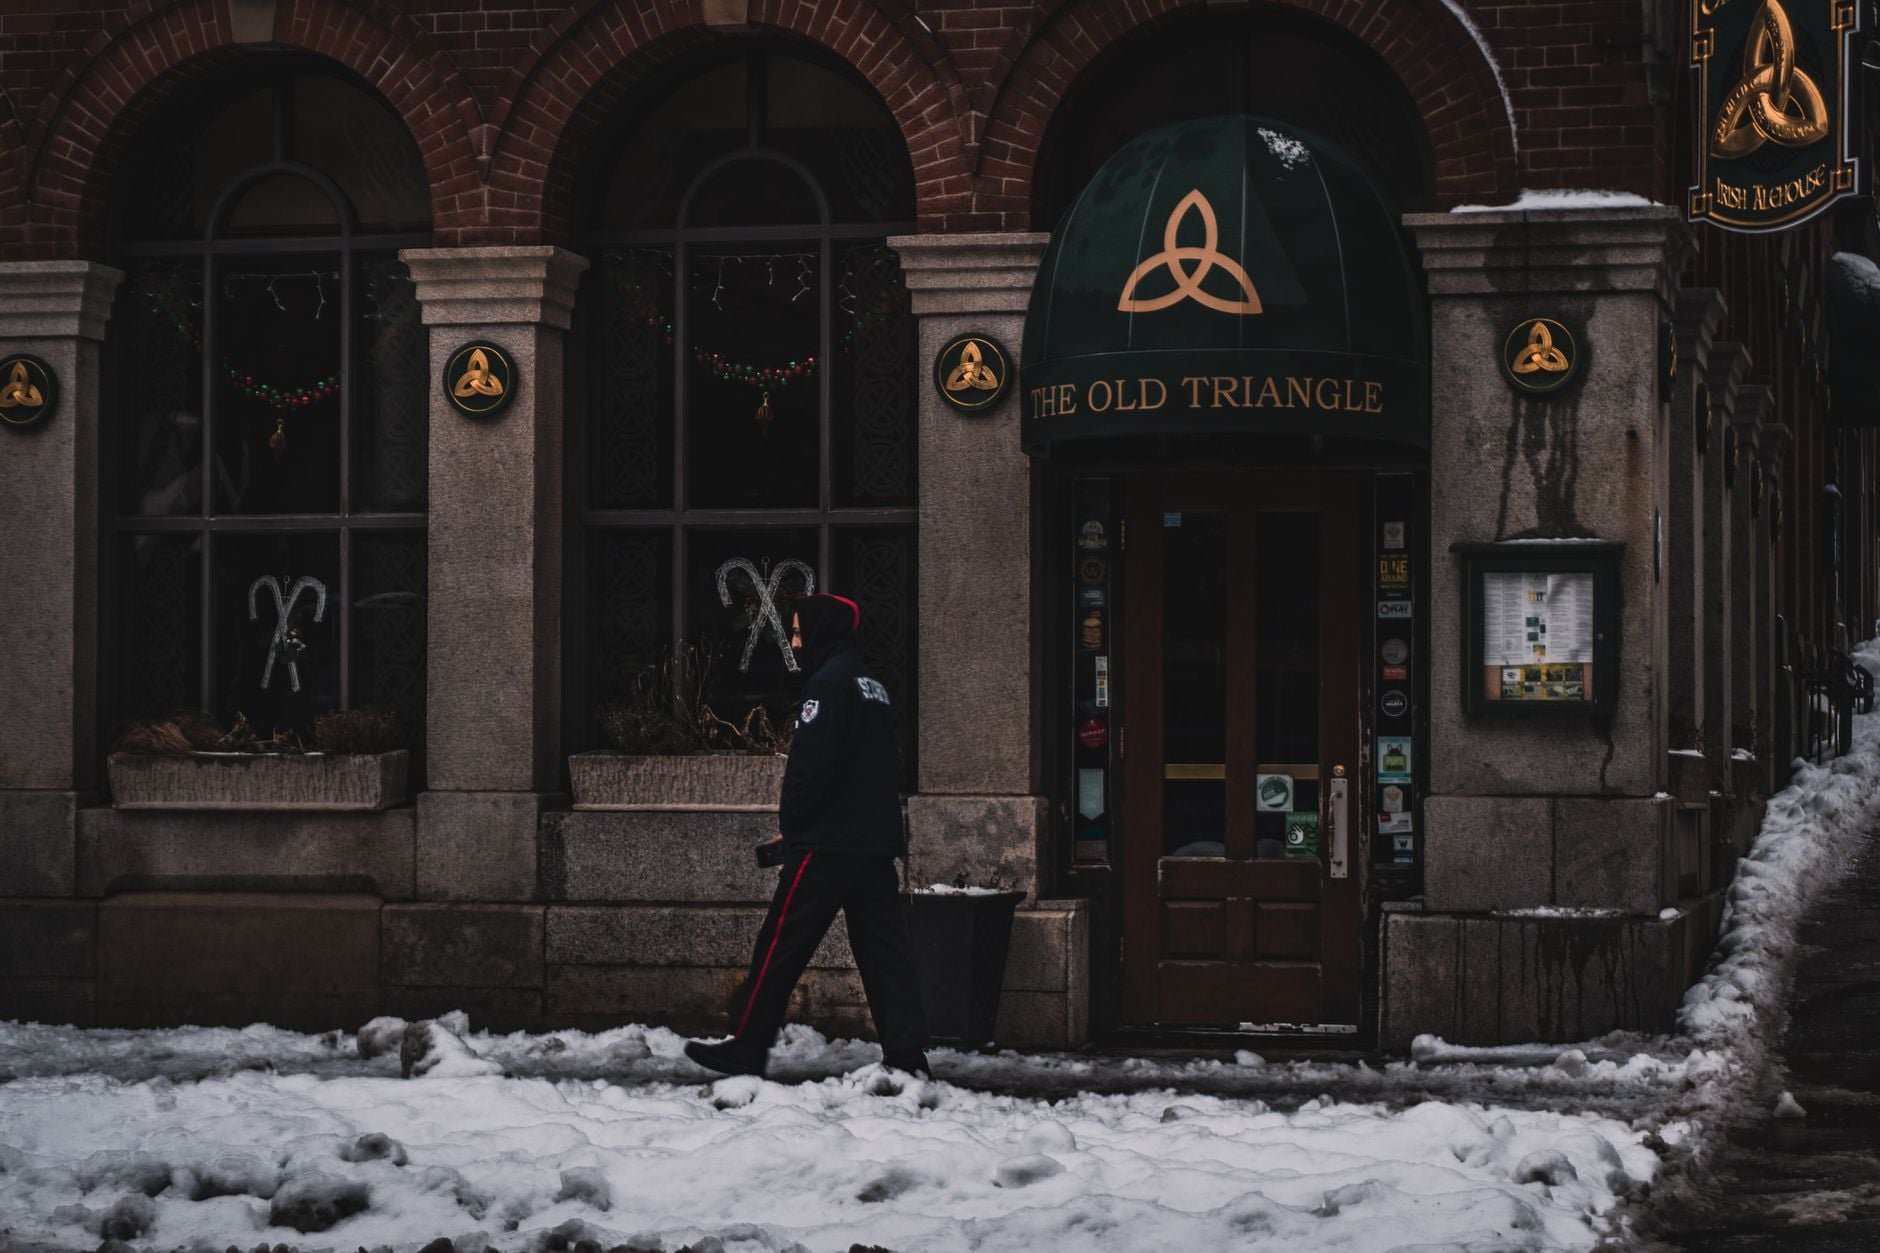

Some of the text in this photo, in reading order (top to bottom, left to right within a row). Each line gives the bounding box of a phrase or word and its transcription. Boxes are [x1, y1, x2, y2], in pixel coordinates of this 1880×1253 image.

[1030, 375, 1384, 419] THE OLD TRIANGLE
